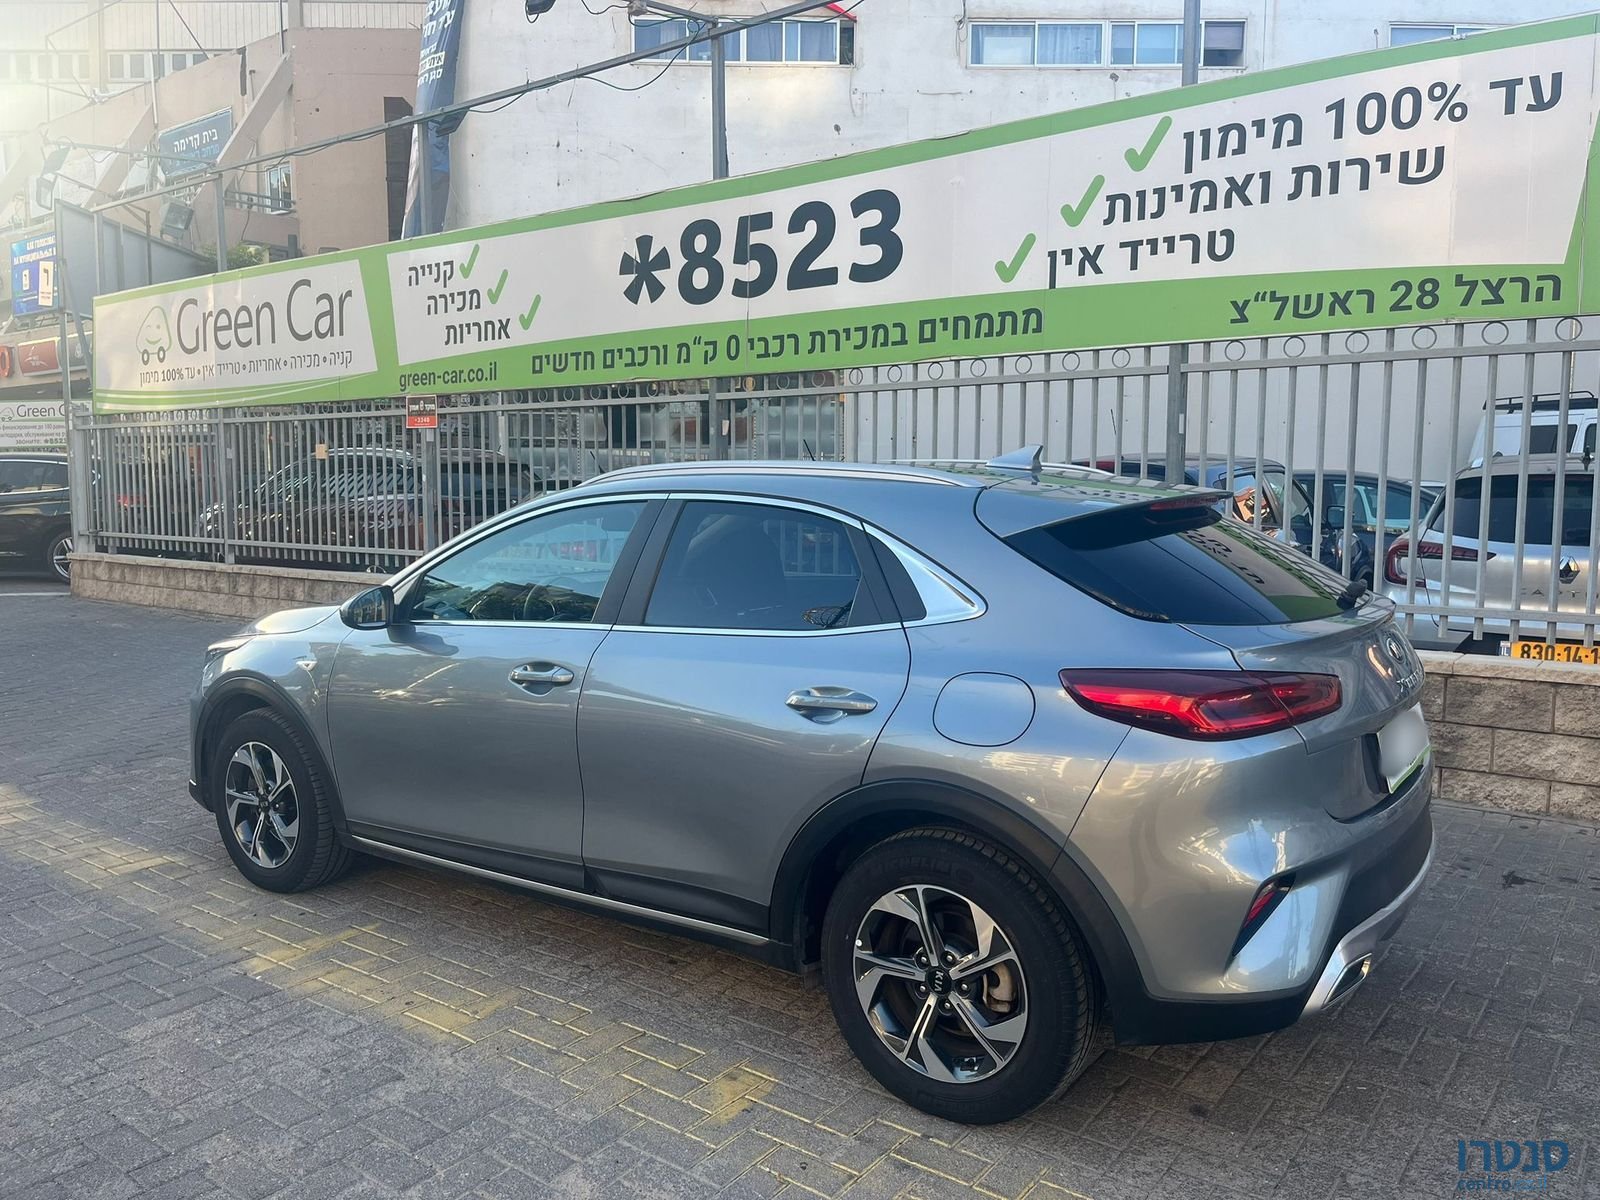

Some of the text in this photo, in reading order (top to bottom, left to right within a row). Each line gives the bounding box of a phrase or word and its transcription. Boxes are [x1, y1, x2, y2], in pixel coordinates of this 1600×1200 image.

[1183, 71, 1563, 174] עד 100% מימון
[173, 128, 218, 153] בית קדימה
[1103, 145, 1445, 226] שירות ואמינות
[1047, 228, 1235, 290] טרייד אין
[408, 260, 454, 288] קנייה
[427, 288, 481, 315] מכירה
[1389, 278, 1440, 312] 28
[1455, 273, 1562, 307] הרצל
[176, 278, 353, 355] Green Car
[918, 307, 1043, 344] מתמחים
[444, 318, 511, 346] אחריות
[748, 333, 800, 359] רכבי
[807, 322, 908, 354] במכירת
[602, 344, 668, 369] ורכבים
[726, 334, 740, 361] 0
[139, 350, 353, 388] קניה מכירה אחריות טרייד אין עד 100% מימון
[399, 361, 497, 392] green-car.co.il
[532, 351, 595, 374] חדשים
[16, 404, 55, 417] Green
[934, 971, 944, 992] KIA
